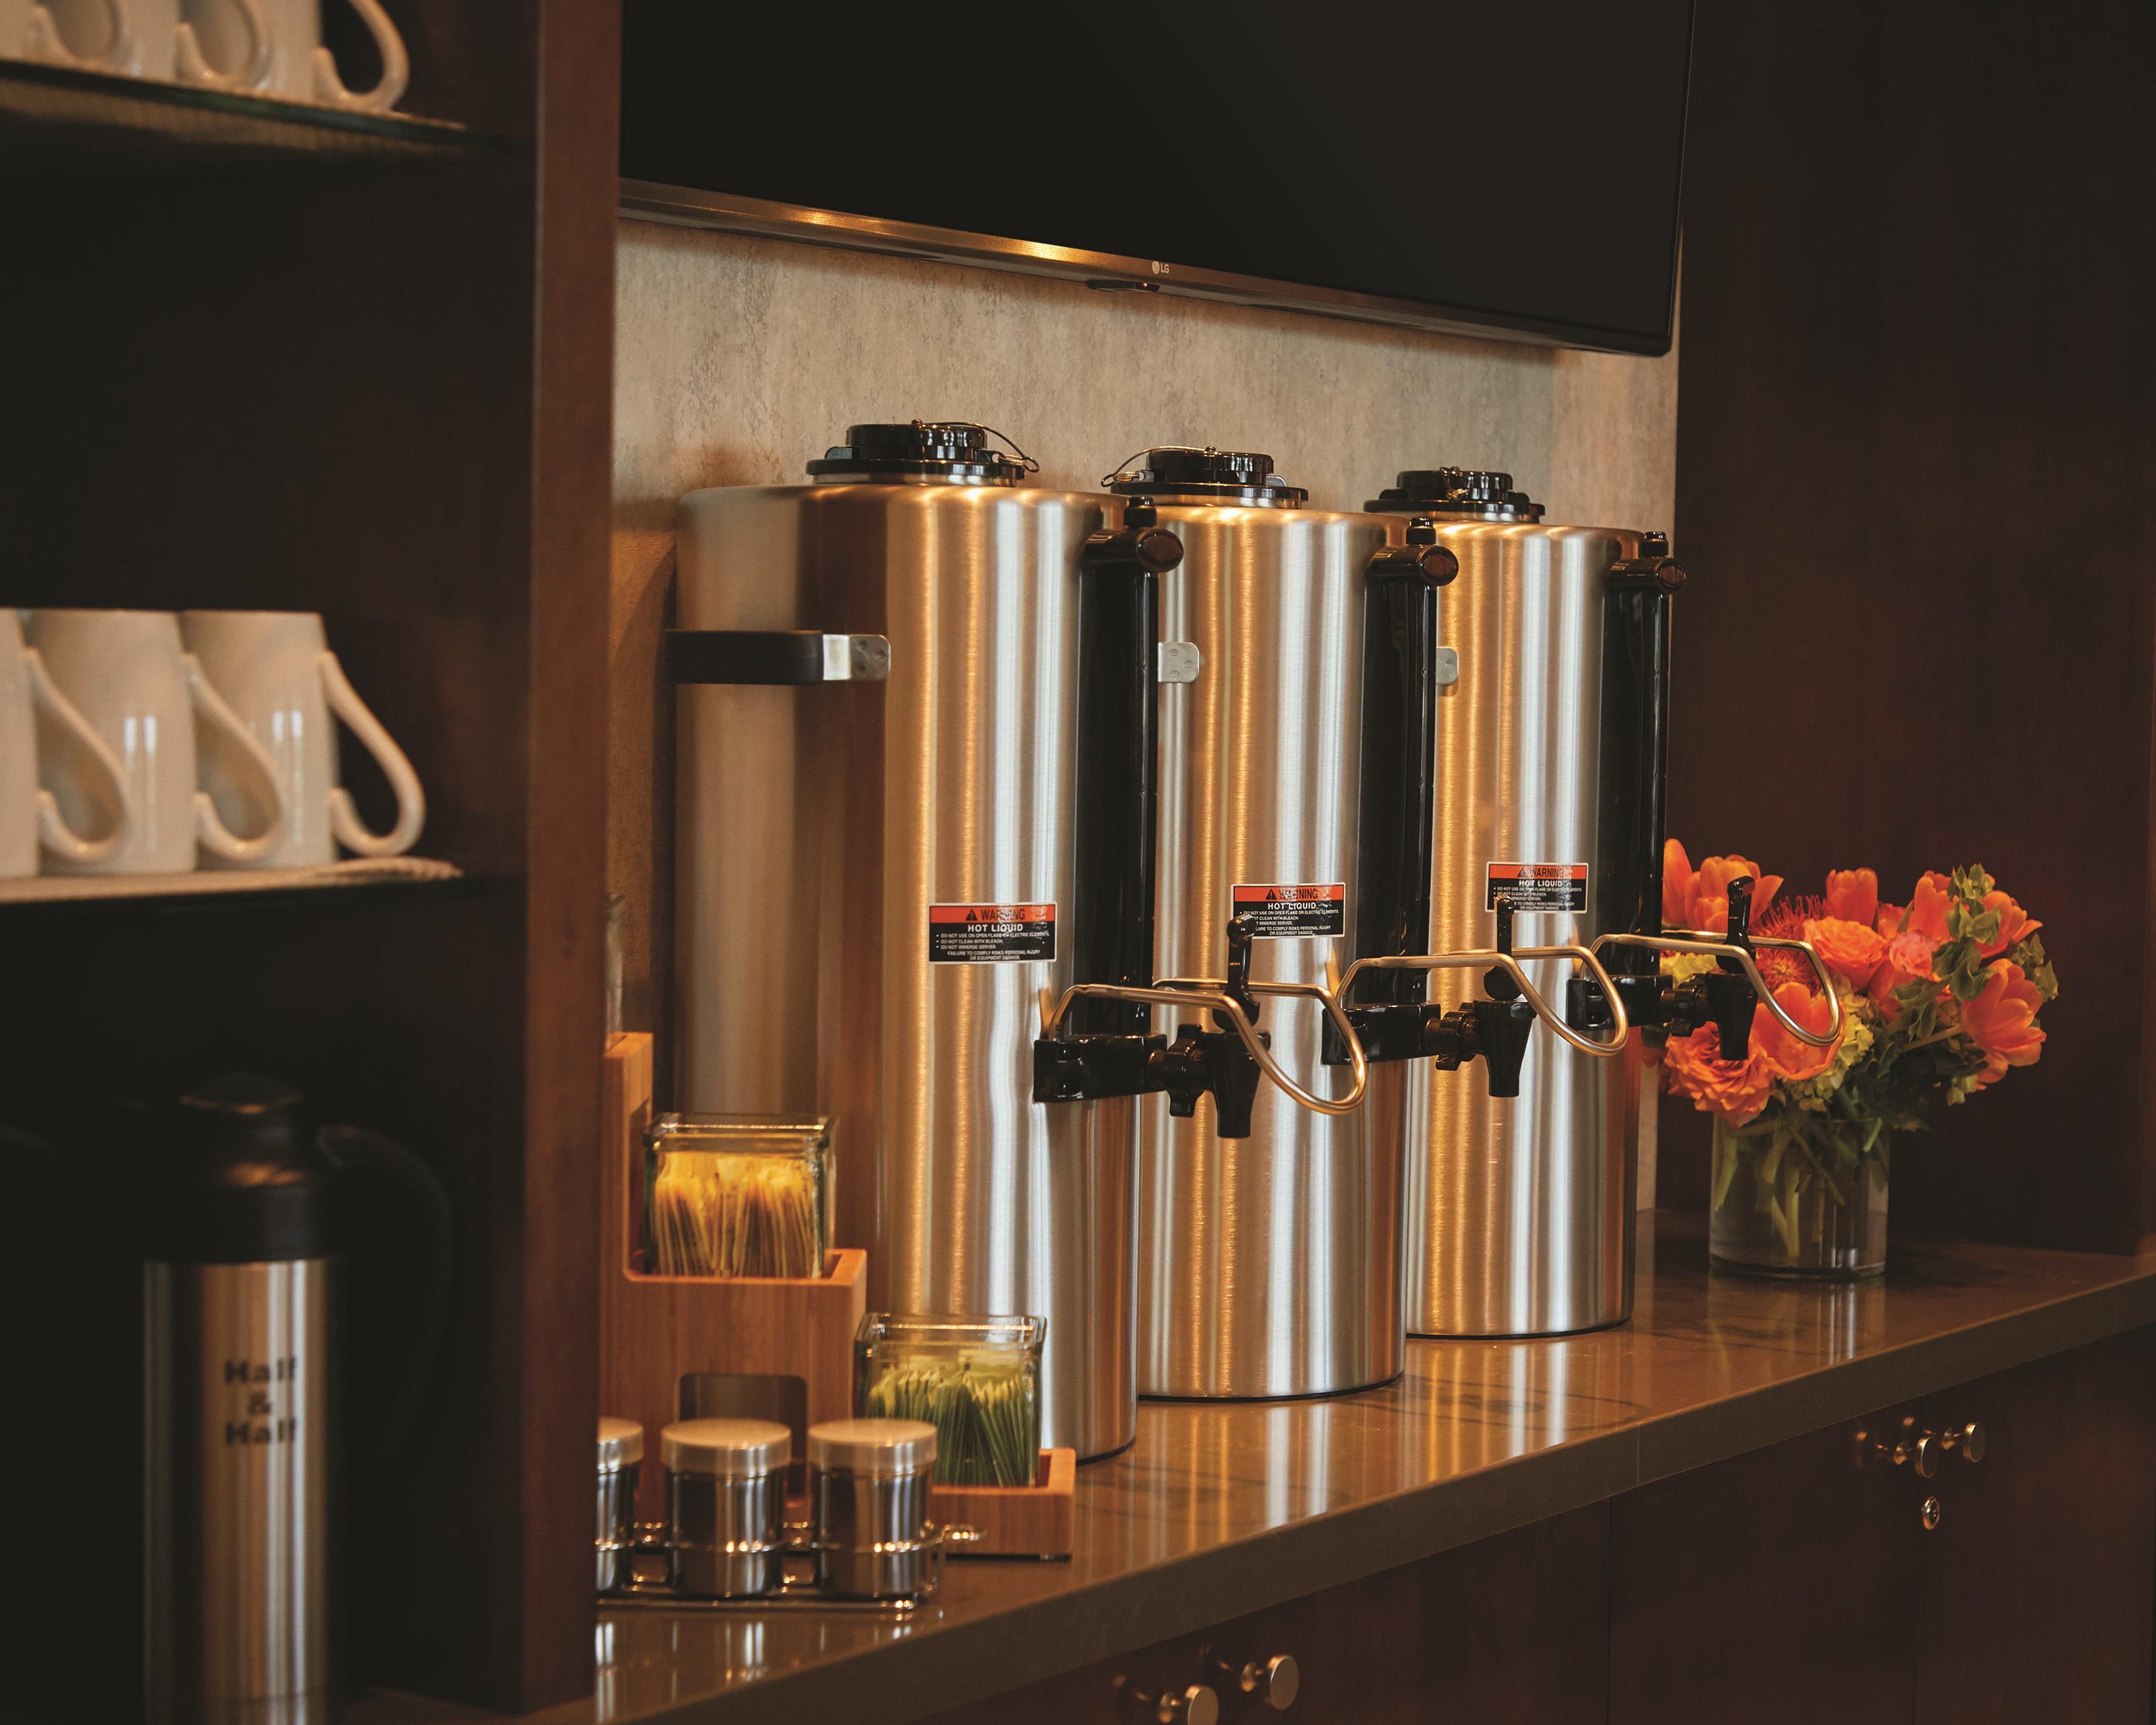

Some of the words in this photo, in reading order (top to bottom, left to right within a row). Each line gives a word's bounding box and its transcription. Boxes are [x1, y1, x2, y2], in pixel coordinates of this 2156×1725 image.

[1161, 262, 1170, 274] LG
[1529, 868, 1564, 878] WARNING
[992, 924, 1023, 932] LIQUID
[225, 1357, 295, 1384] Half
[225, 1419, 295, 1446] Half
